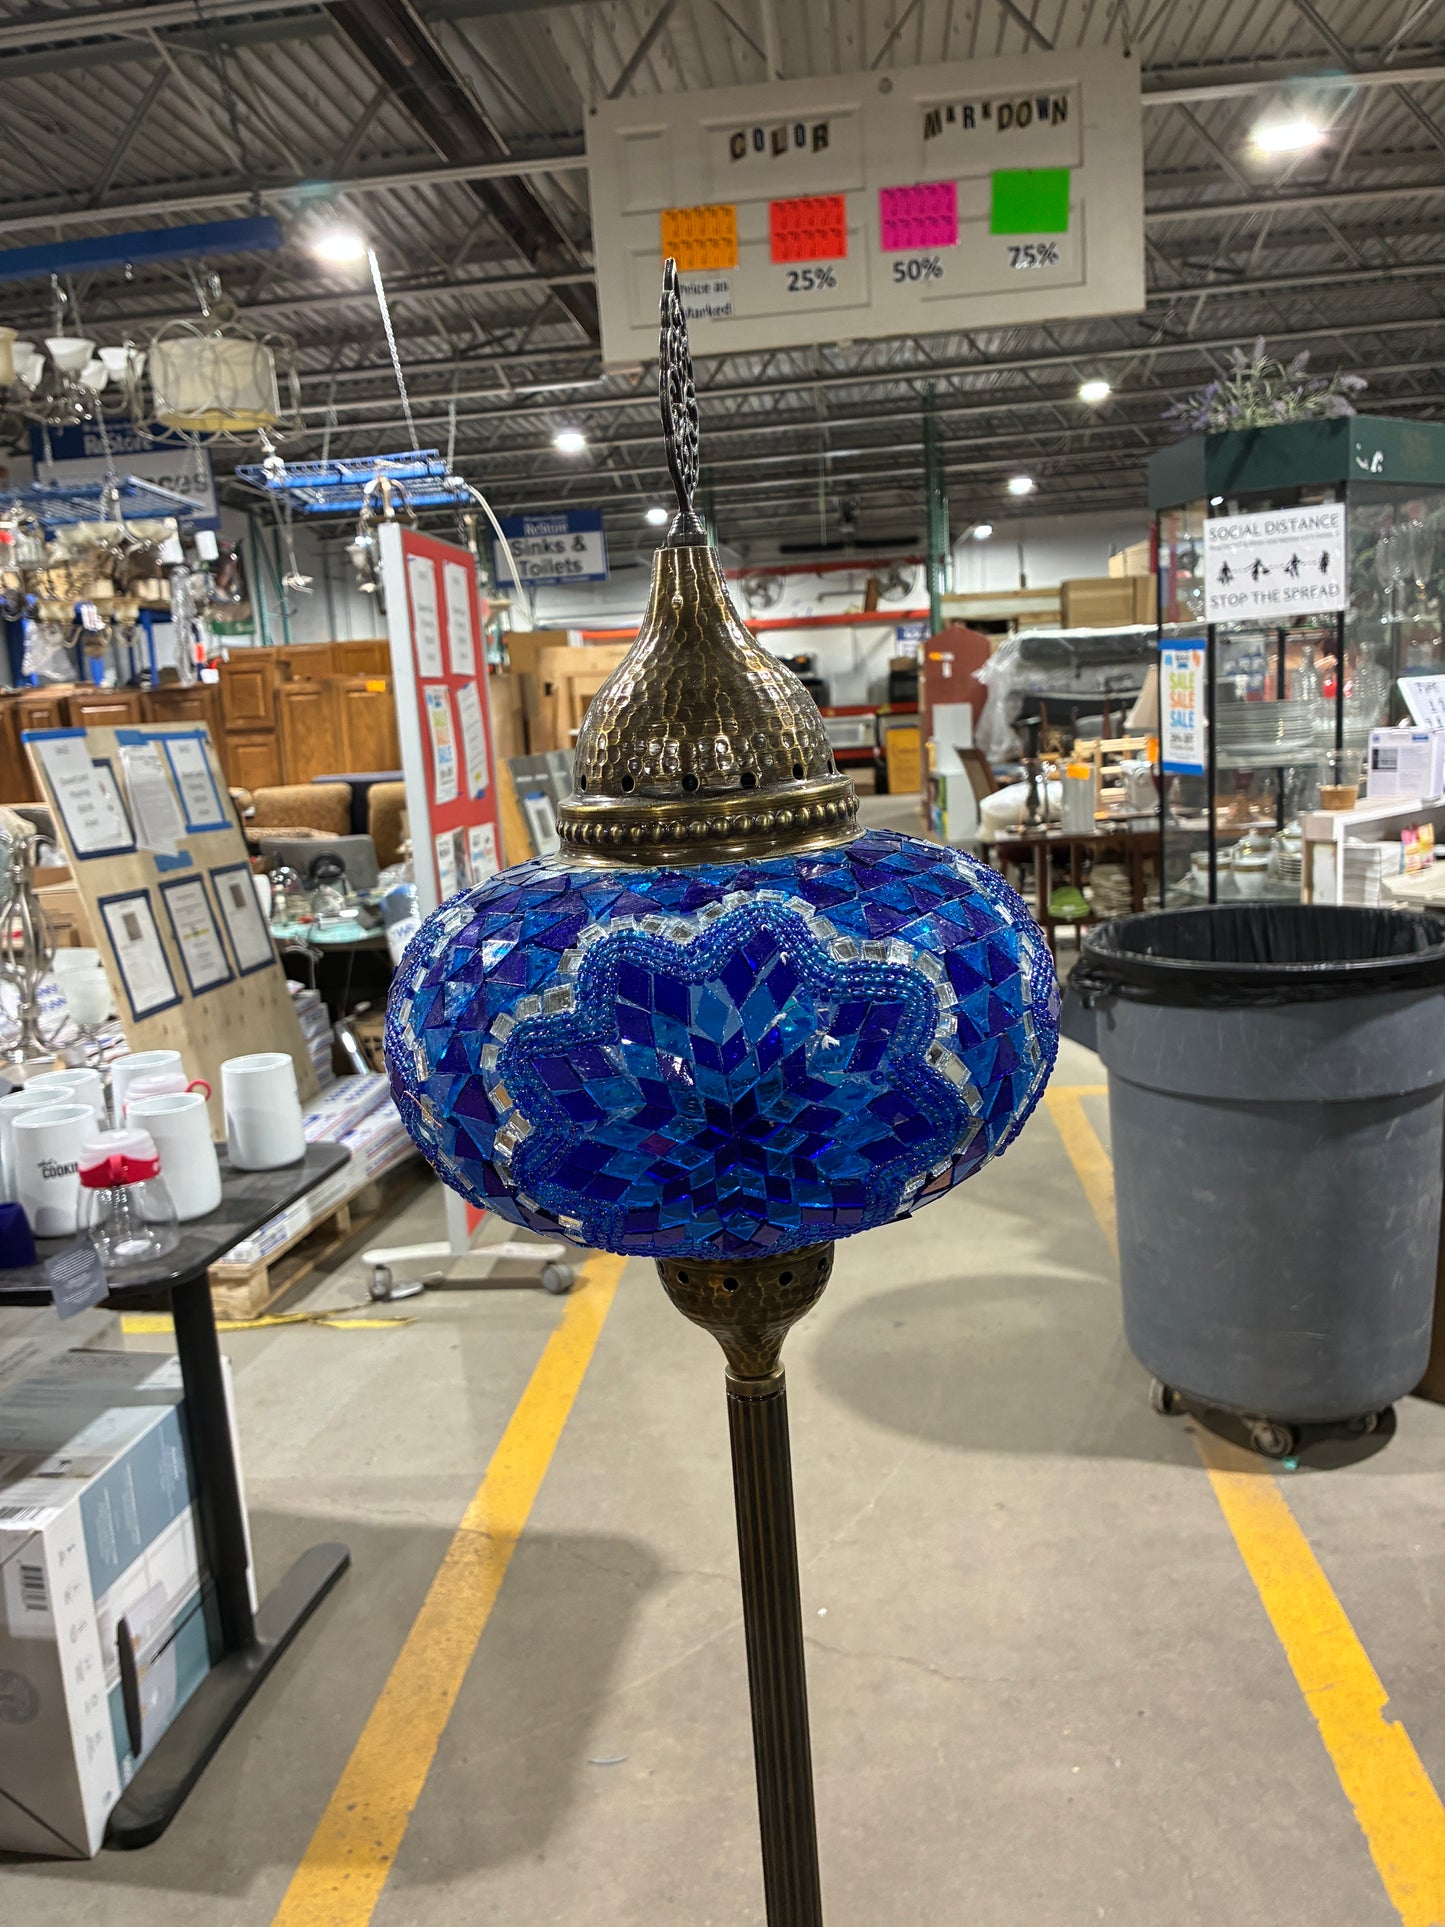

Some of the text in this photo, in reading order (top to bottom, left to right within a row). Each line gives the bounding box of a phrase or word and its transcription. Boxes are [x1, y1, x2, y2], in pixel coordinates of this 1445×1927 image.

[730, 97, 1069, 162] COLOR MARKDOWN
[1007, 241, 1059, 269] 75%
[787, 266, 837, 292] 25%
[893, 256, 943, 283] 50%
[1209, 524, 1260, 541] SOCIAL
[1264, 513, 1340, 535] DISTANCE
[511, 535, 587, 557] Sinks &
[519, 559, 583, 577] Toilets
[1210, 583, 1341, 609] STOP THE SPREAD
[1169, 671, 1195, 690] SALE
[1170, 691, 1195, 709] SALE
[1170, 709, 1195, 729] SALE
